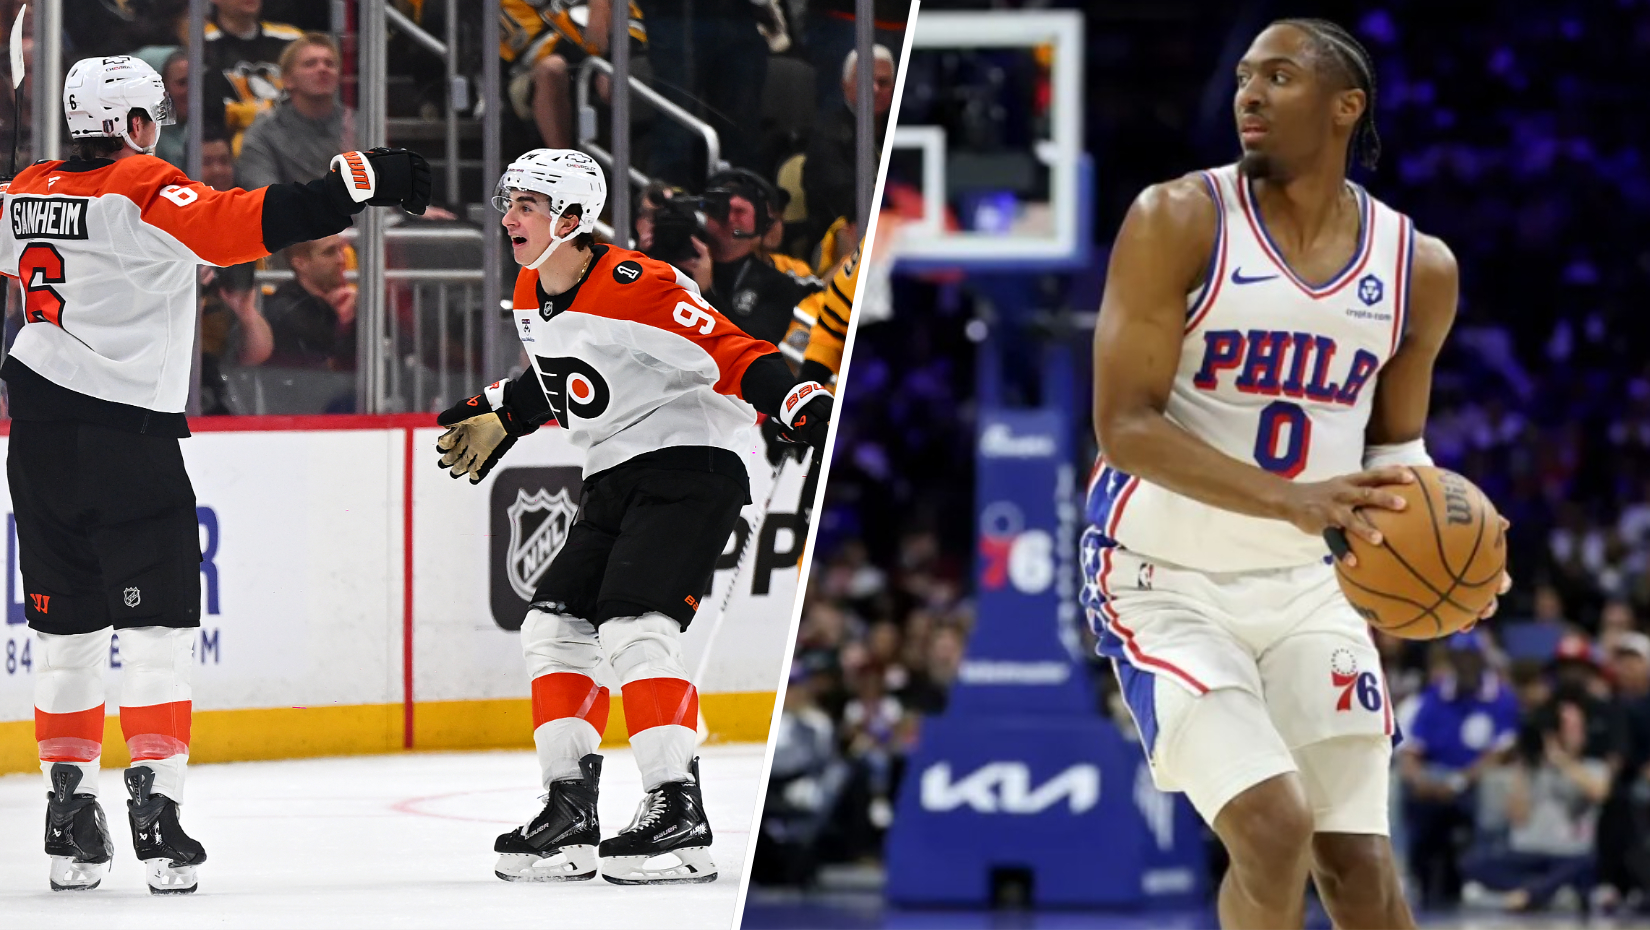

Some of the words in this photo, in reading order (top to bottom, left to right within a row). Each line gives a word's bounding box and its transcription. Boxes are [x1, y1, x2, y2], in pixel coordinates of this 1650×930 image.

[69, 93, 77, 110] 6
[159, 185, 197, 206] 6
[14, 201, 81, 236] SANHEIM
[18, 242, 66, 328] 6
[617, 264, 639, 280] 1
[1253, 399, 1312, 481] 0
[523, 520, 565, 582] NHL
[1331, 671, 1382, 712] 76
